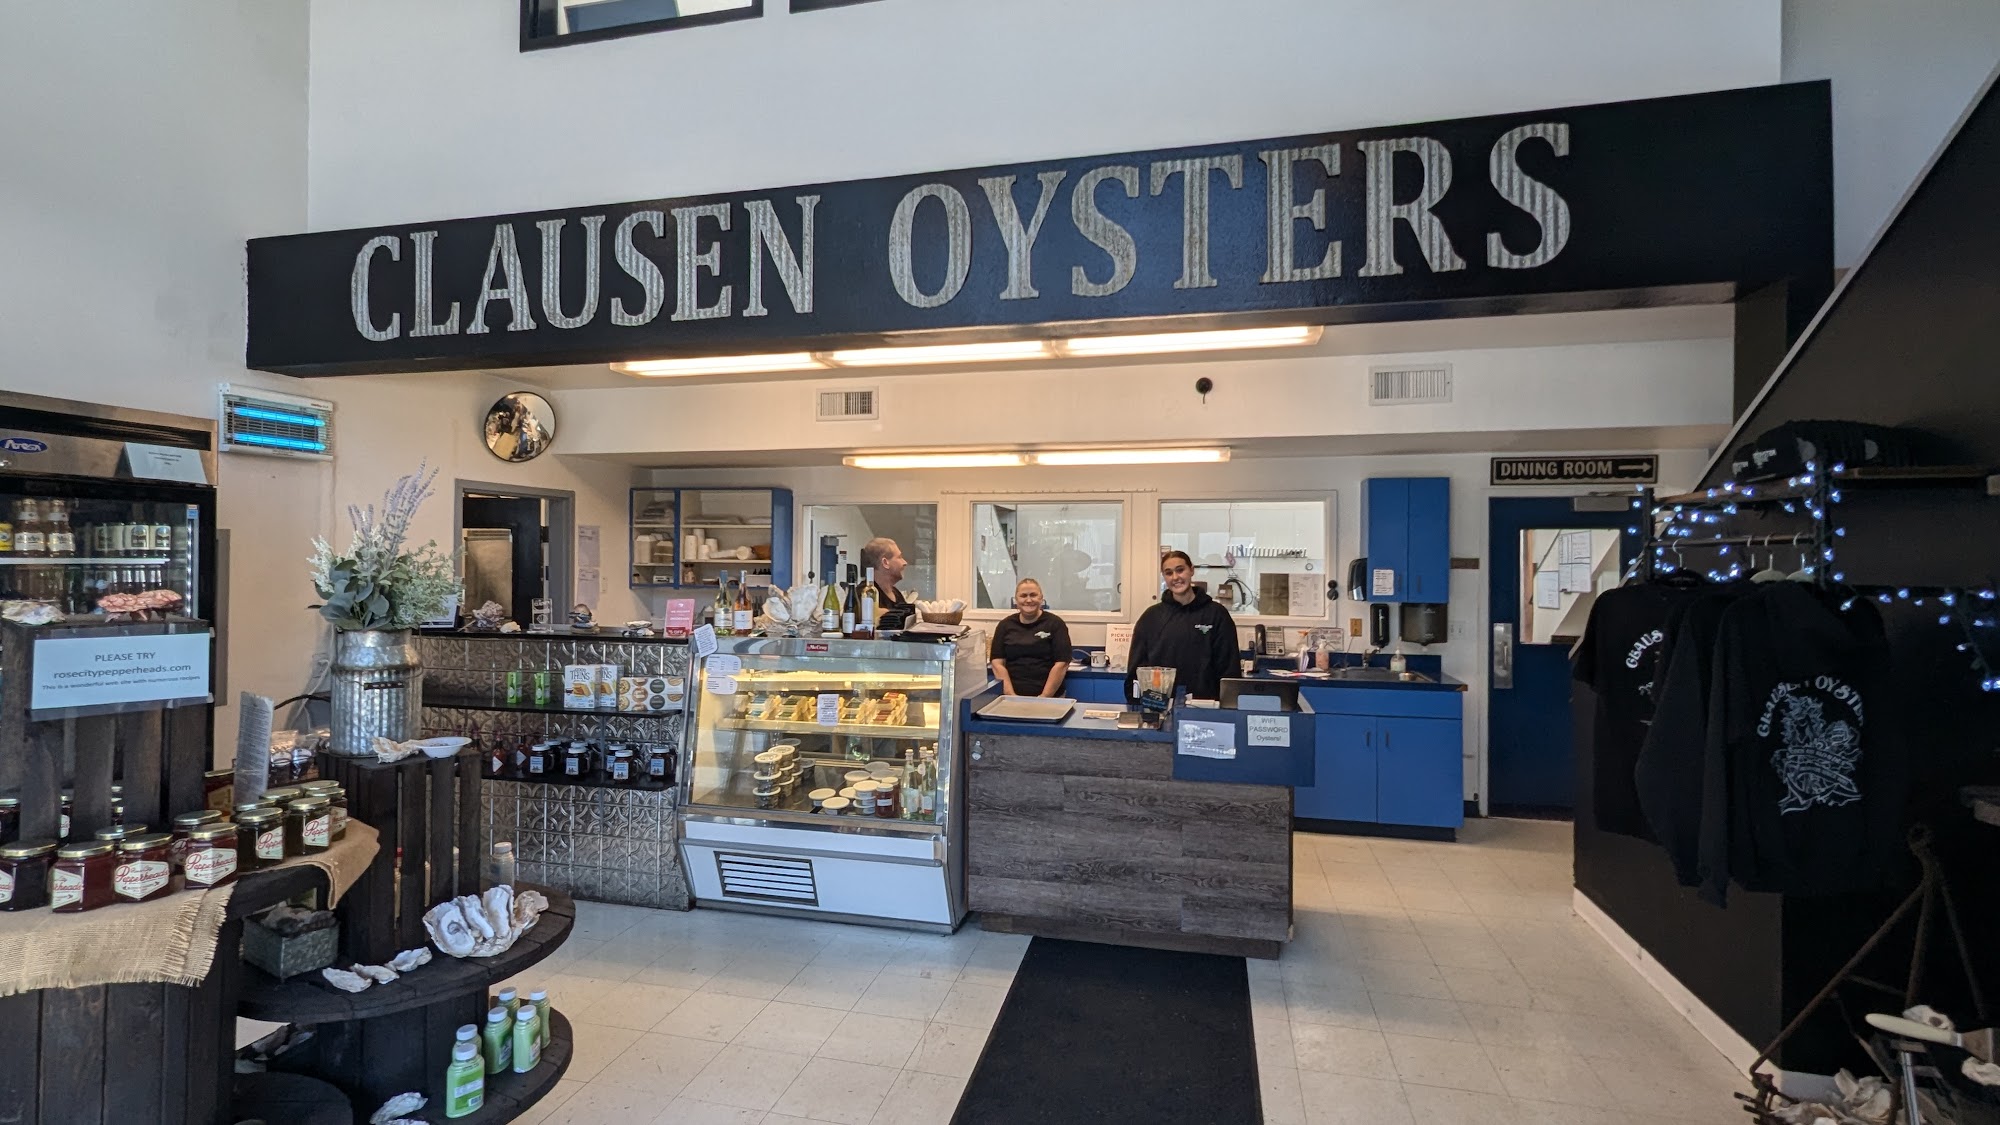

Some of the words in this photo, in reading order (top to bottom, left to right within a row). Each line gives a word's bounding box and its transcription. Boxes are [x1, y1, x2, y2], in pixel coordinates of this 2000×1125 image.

[351, 195, 821, 342] CLAUSEN
[888, 122, 1571, 308] OYSTERS
[1501, 461, 1558, 476] DINING
[1563, 461, 1613, 476] ROOM
[95, 653, 133, 662] PLEASE
[137, 651, 156, 660] TRY
[1625, 629, 1664, 669] CLAUS
[54, 664, 191, 679] rosecitypepperheads.com
[1814, 675, 1864, 727] OYSTE
[1249, 726, 1289, 734] PASSWORD
[186, 852, 238, 871] Pepperheads
[115, 865, 169, 883] Pepperheads
